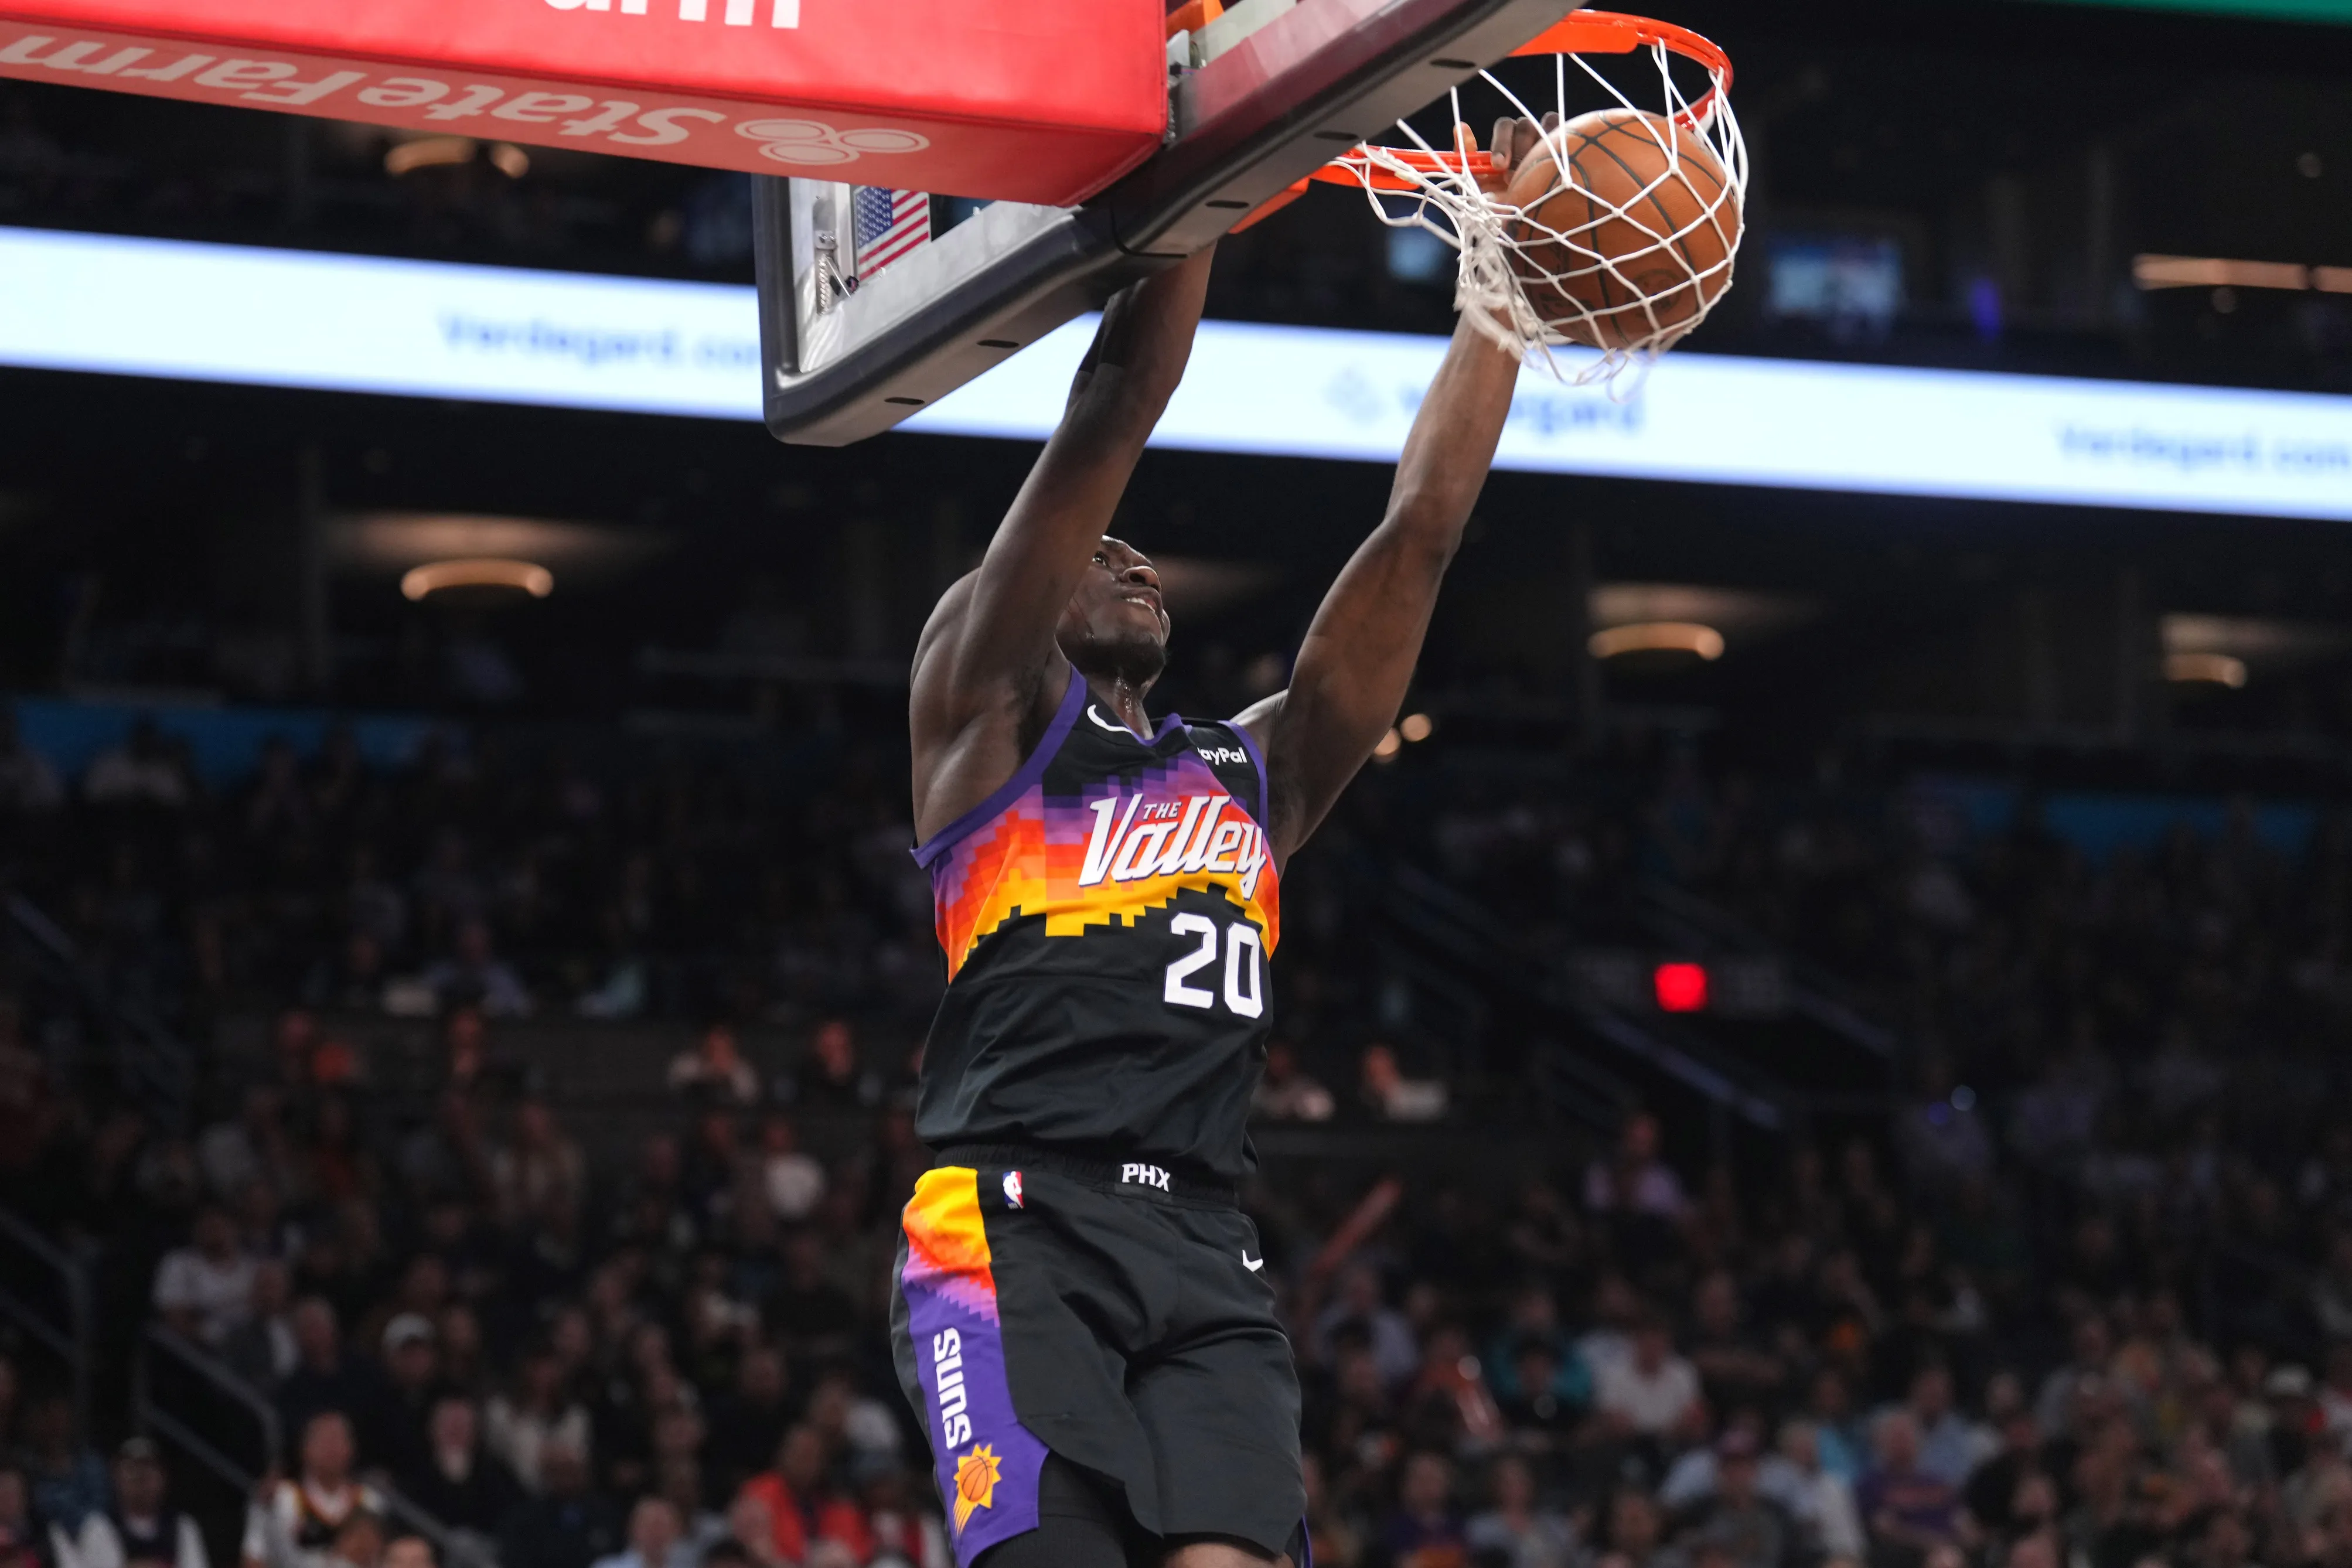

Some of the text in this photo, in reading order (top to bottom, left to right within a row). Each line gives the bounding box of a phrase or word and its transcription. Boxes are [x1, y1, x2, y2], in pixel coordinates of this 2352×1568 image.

[437, 311, 760, 369] Verdegard.co
[1197, 747, 1247, 765] ayPal
[1143, 802, 1181, 820] THE
[1078, 793, 1267, 901] Valley
[1163, 912, 1263, 1018] 20
[1122, 1163, 1171, 1192] PHX
[933, 1327, 972, 1450] SUNS
